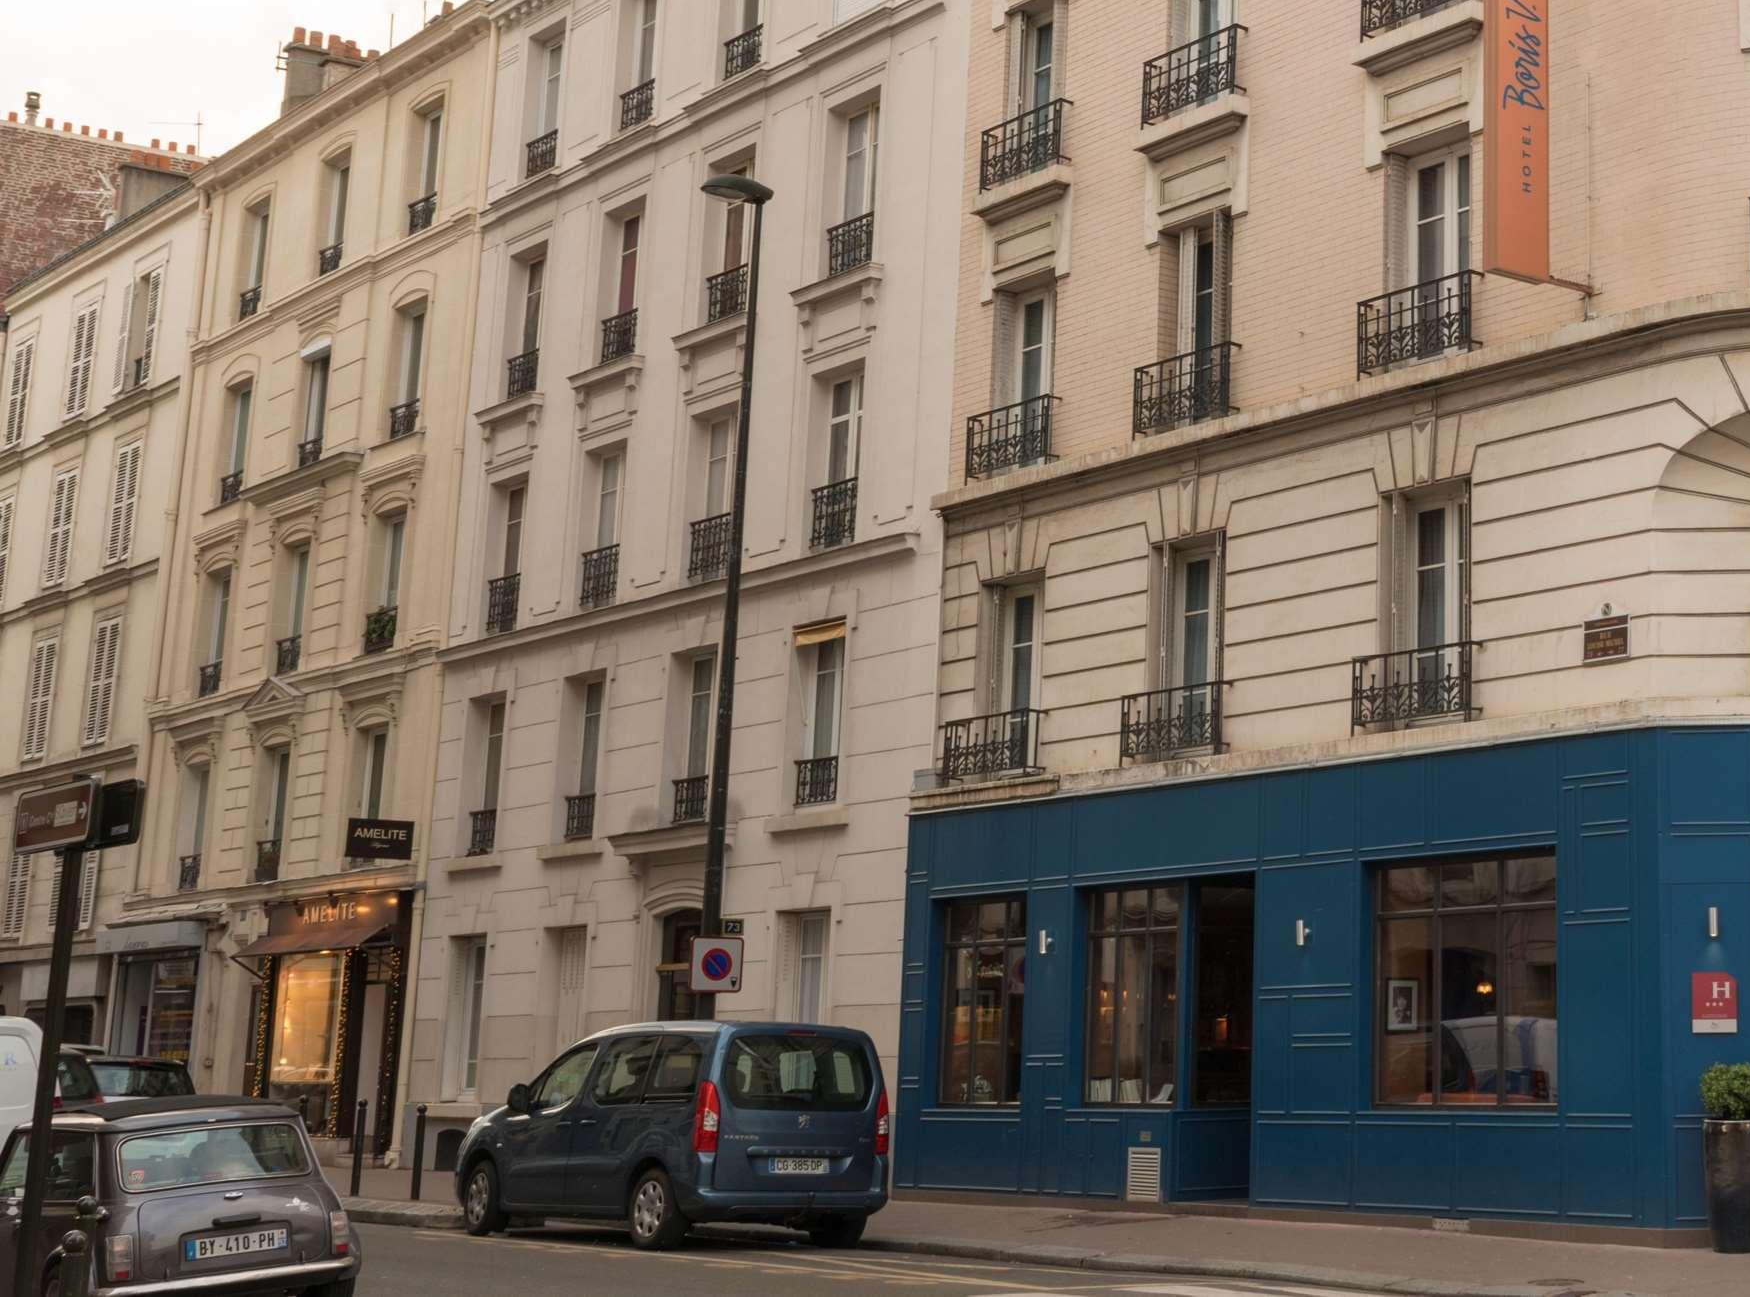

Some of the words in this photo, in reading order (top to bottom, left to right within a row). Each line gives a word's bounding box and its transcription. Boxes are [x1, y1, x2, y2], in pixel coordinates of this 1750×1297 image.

[1502, 25, 1545, 111] Boris
[1521, 124, 1532, 194] HOTEL
[354, 827, 408, 841] AMELITE
[302, 902, 357, 925] AMELITE
[1712, 981, 1731, 999] H
[199, 1232, 275, 1256] BY-410-PH
